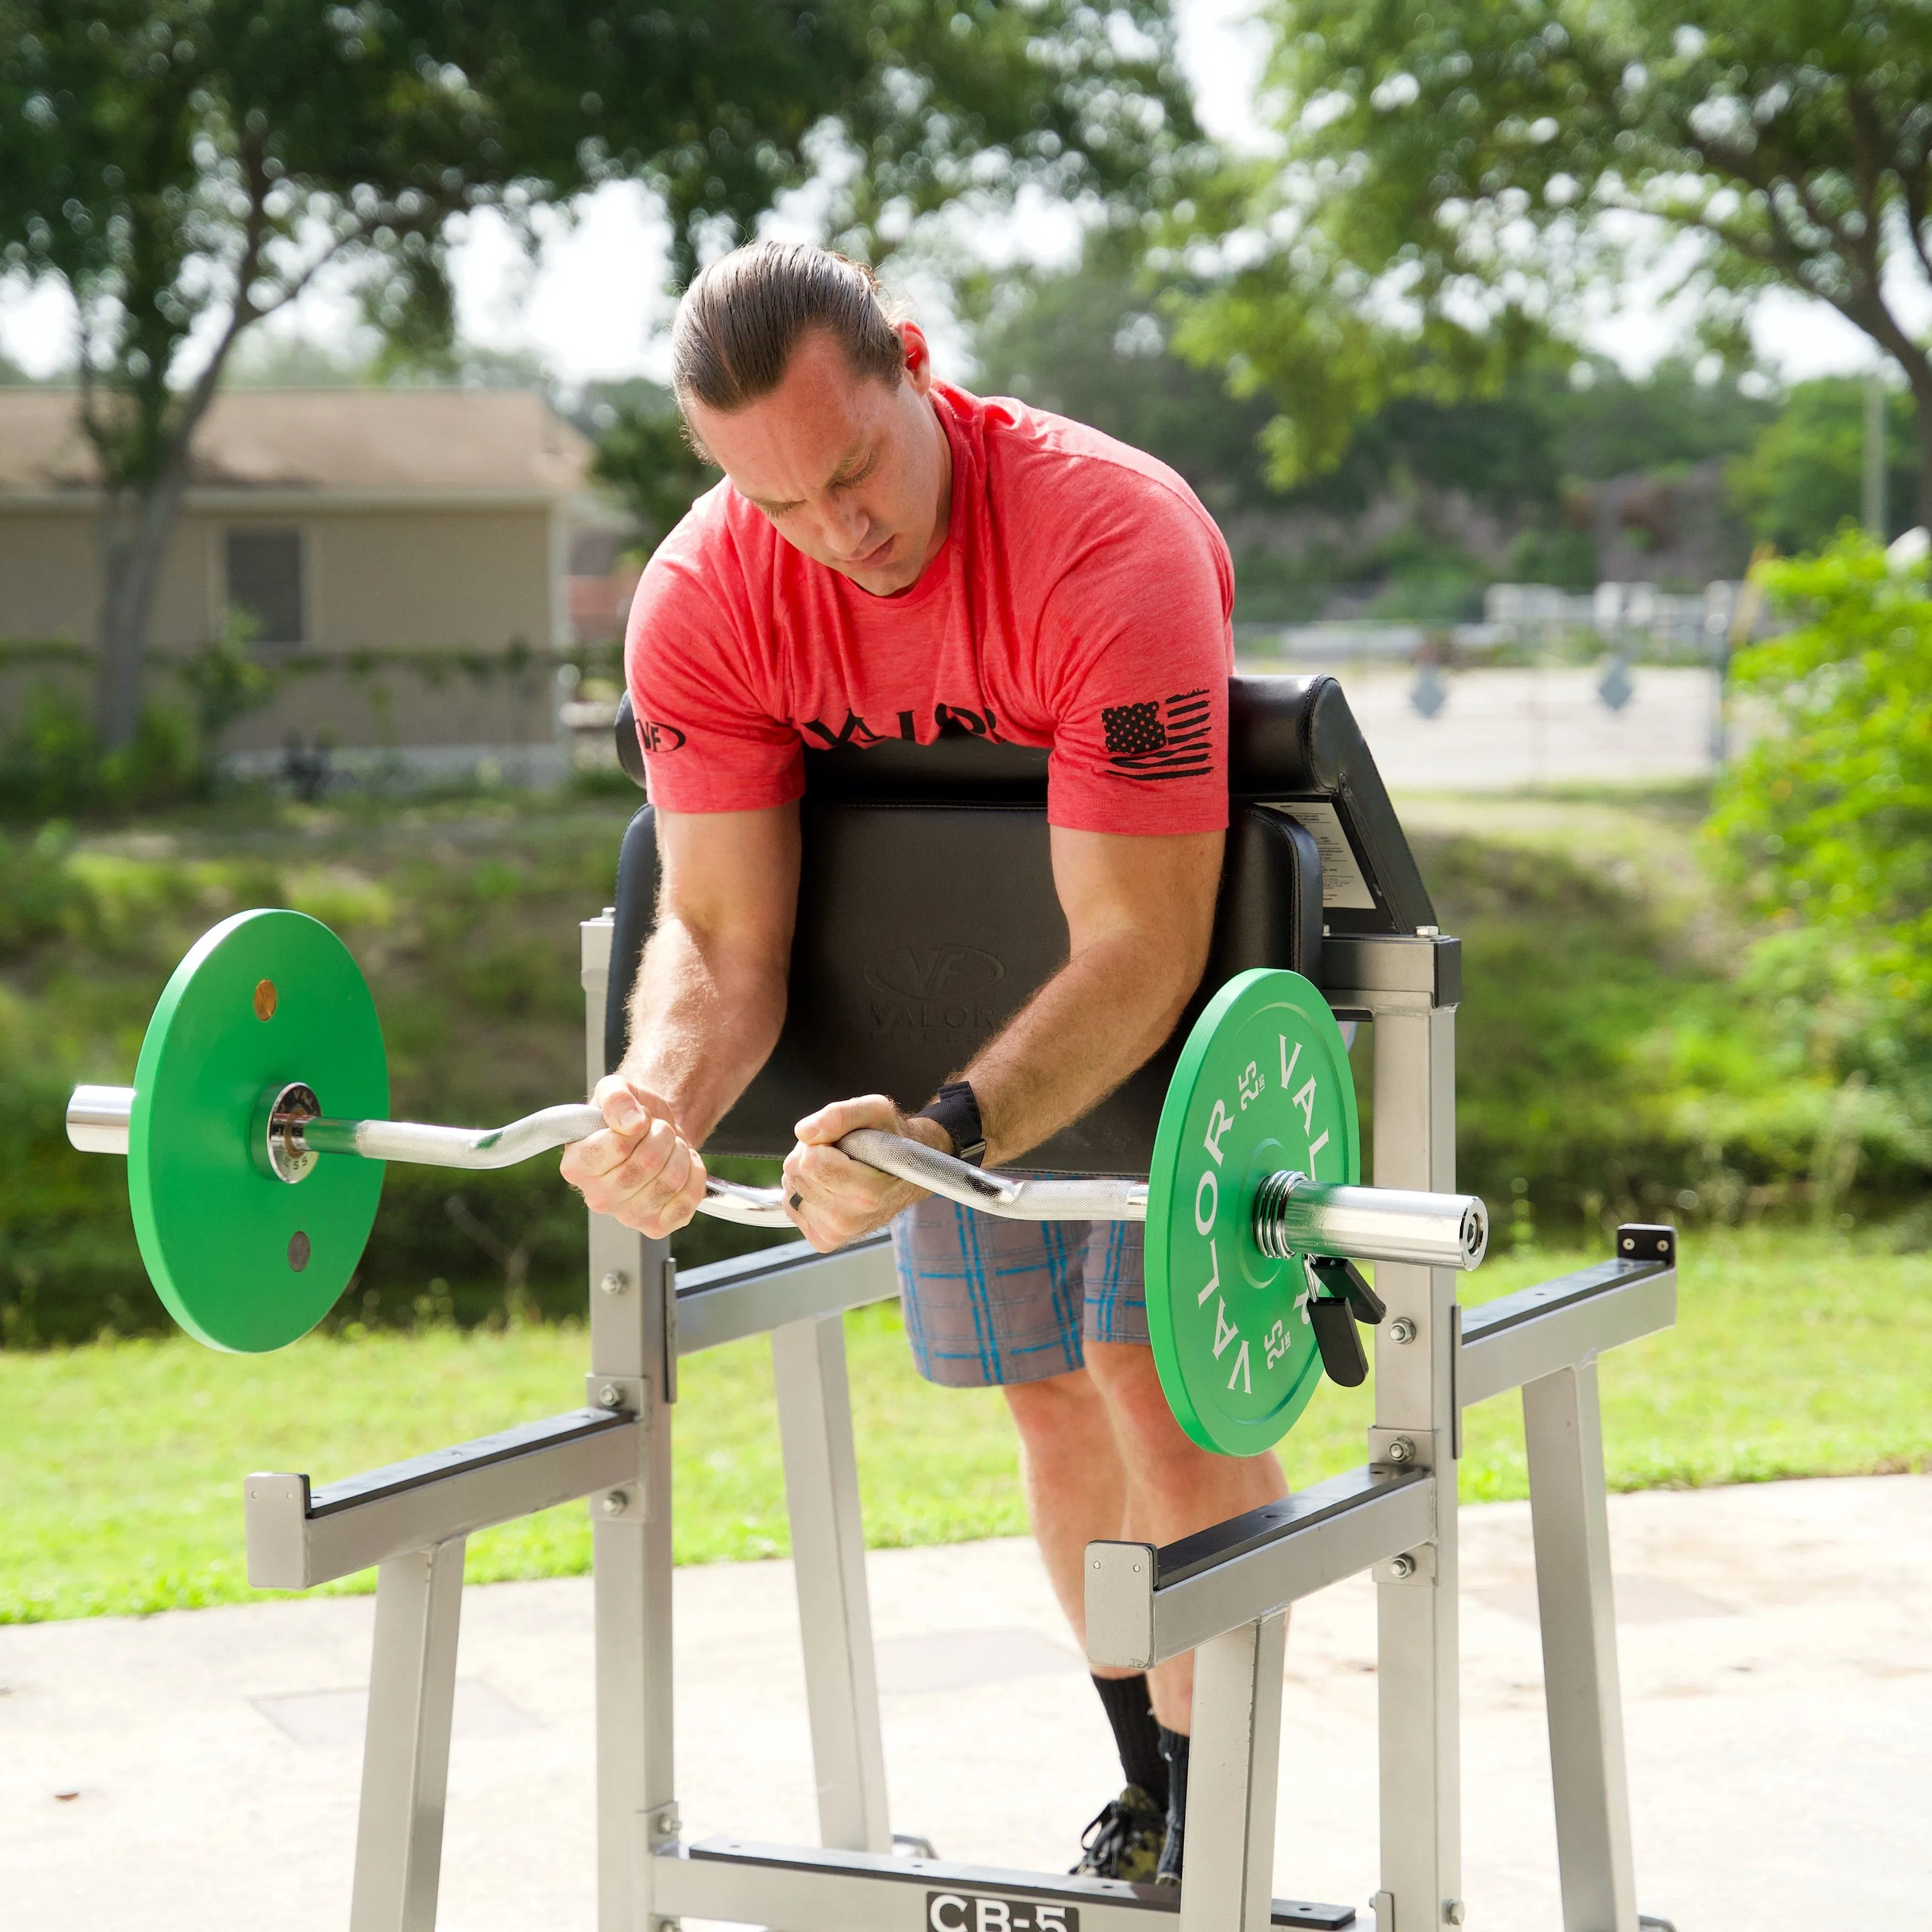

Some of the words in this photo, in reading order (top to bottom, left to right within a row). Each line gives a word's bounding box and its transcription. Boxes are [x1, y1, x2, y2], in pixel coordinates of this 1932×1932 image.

[869, 1001, 999, 1029] VALOR
[1238, 1060, 1259, 1111] 25
[1195, 1099, 1252, 1394] VALOR
[1264, 1319, 1285, 1370] 25
[930, 1894, 1068, 1932] CB-5
